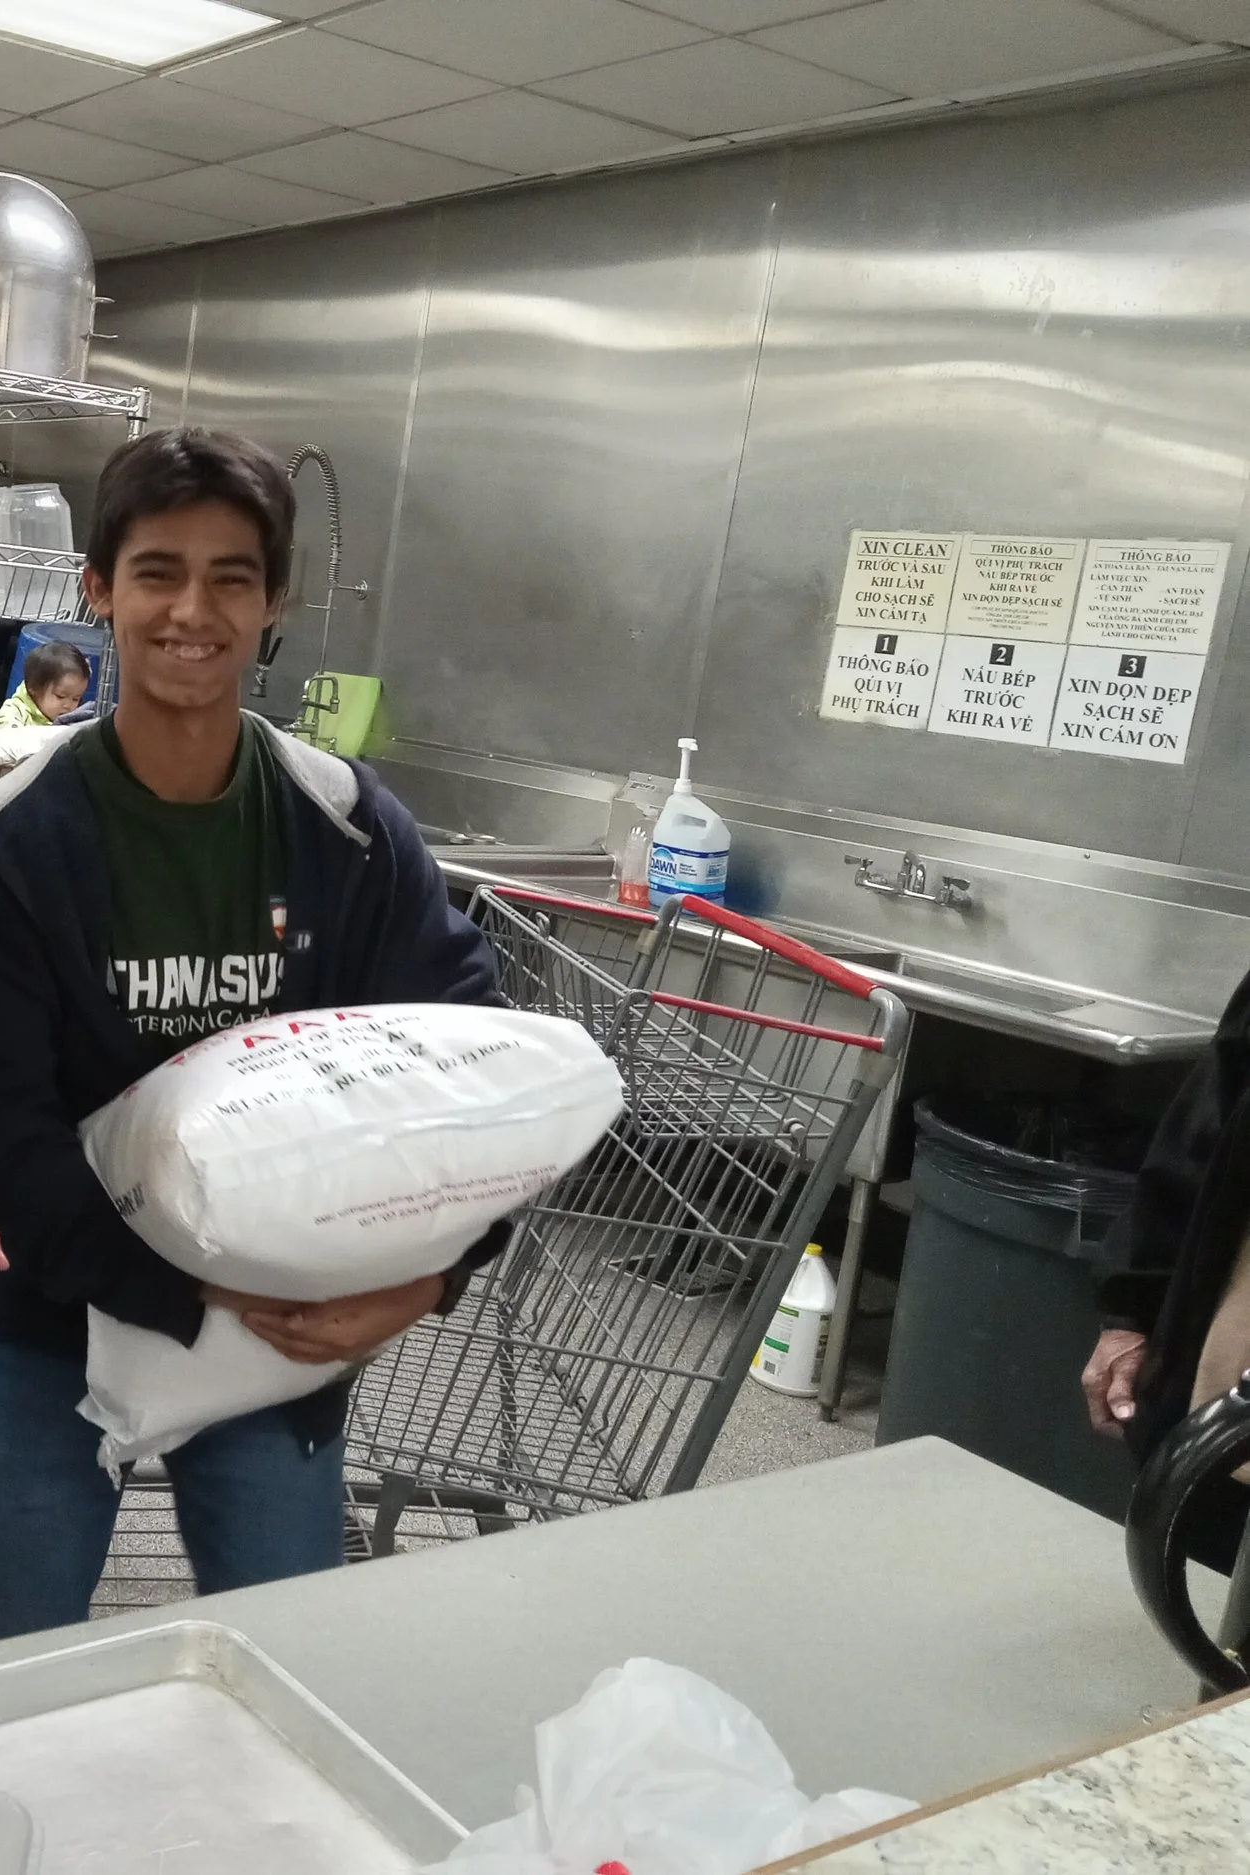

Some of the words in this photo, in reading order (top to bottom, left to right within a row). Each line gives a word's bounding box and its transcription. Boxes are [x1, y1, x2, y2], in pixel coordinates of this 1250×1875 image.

[862, 541, 890, 554] XIN
[893, 542, 948, 557] CLEAN
[921, 563, 946, 574] SAU
[871, 577, 893, 588] KHI
[989, 582, 1007, 592] KHI
[1009, 584, 1022, 593] RA
[855, 591, 881, 603] CHO
[883, 593, 917, 606] SẠCH
[962, 593, 978, 601] XIN
[856, 607, 877, 617] XIN
[911, 611, 927, 624] TẠ
[996, 646, 1007, 663] 2
[838, 654, 892, 673] THÔNG
[896, 658, 929, 677] BÁO
[1125, 657, 1138, 675] 3
[854, 675, 882, 694] QÚI
[887, 681, 902, 698] VỊ
[1067, 678, 1102, 694] XIN
[1105, 682, 1148, 701] DỌN
[1152, 686, 1192, 706] DẸP
[832, 694, 862, 713] PHỤ
[865, 698, 920, 718] TRÁCH
[964, 689, 1026, 709] TRƯỚC
[945, 709, 978, 725] KHI
[982, 713, 1005, 729] RA
[1083, 702, 1135, 721] SẠCH
[1139, 706, 1164, 725] SẼ
[1061, 722, 1095, 739] XIN
[1099, 725, 1144, 745] CÁM
[1149, 732, 1179, 749] ƠN
